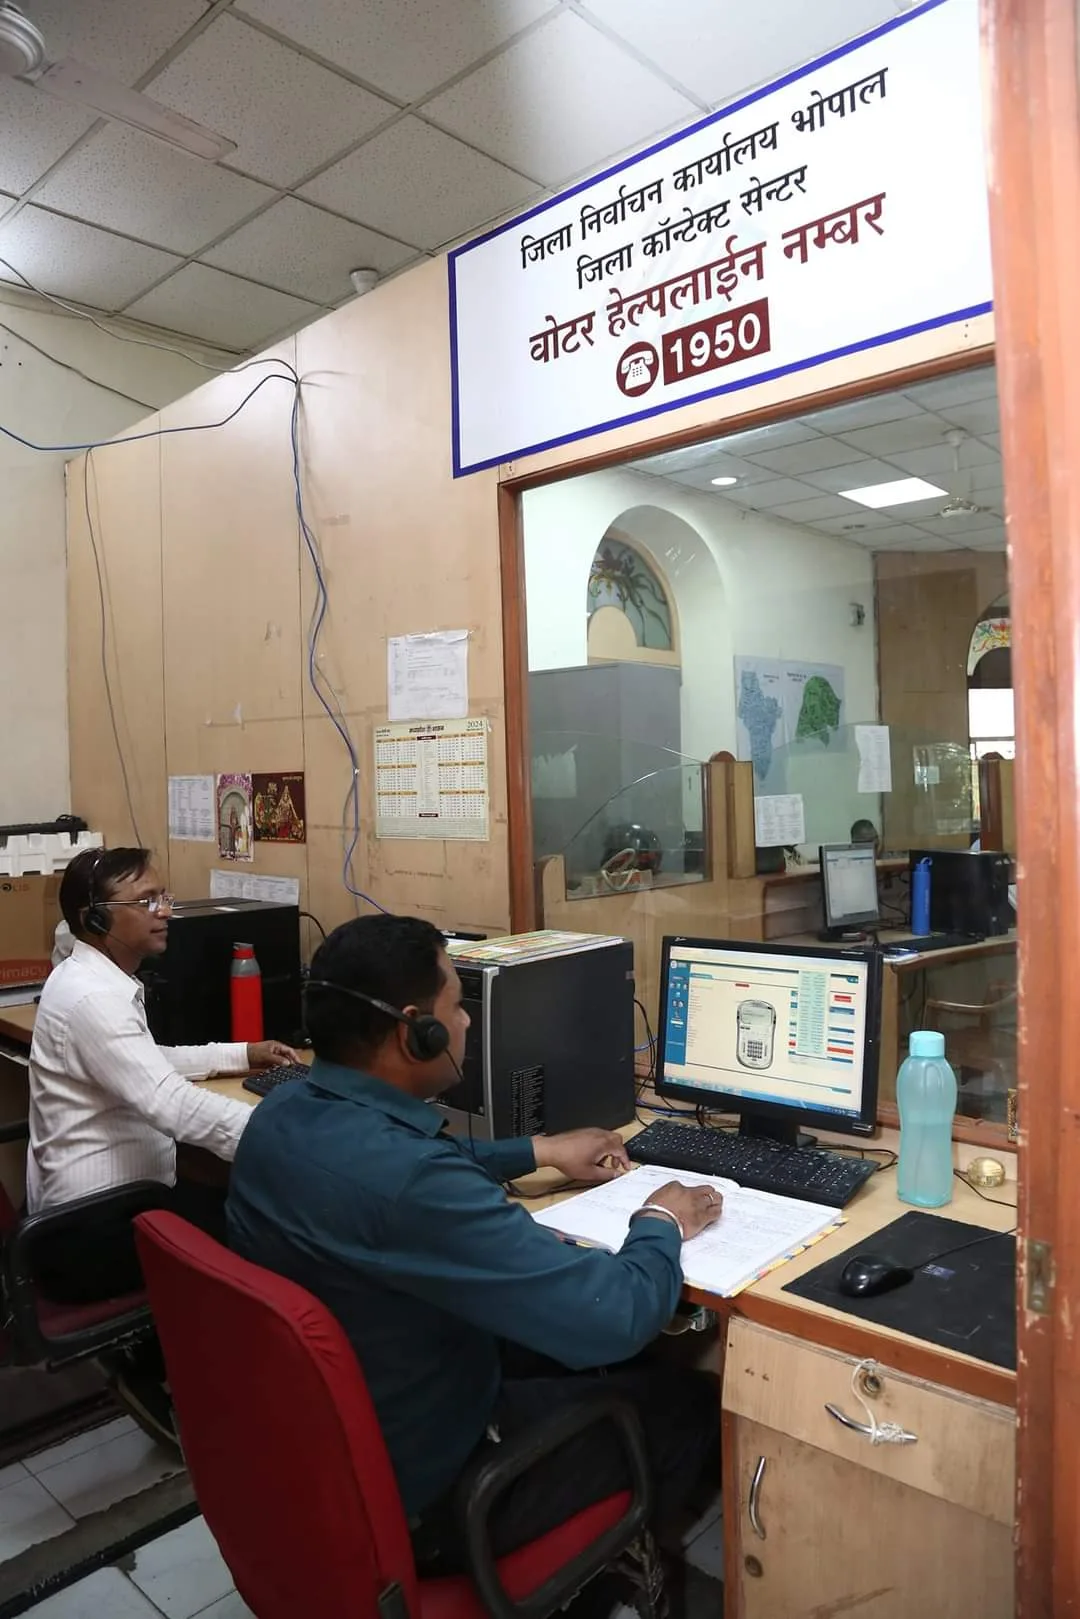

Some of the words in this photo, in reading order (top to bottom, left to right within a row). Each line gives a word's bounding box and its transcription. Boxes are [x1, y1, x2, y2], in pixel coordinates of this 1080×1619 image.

[520, 224, 572, 269] जिला
[580, 178, 663, 240] निर्वाचन
[673, 122, 779, 192] कार्यालय
[791, 67, 889, 132] भोपाल
[577, 243, 633, 289] जिला
[642, 200, 731, 258] कॉन्टेक्ट
[740, 164, 808, 215] सेन्टर
[529, 311, 596, 364] वोटर
[606, 235, 766, 337] हेल्पलाईन
[782, 191, 886, 264] नम्बर
[670, 311, 762, 376] 1950
